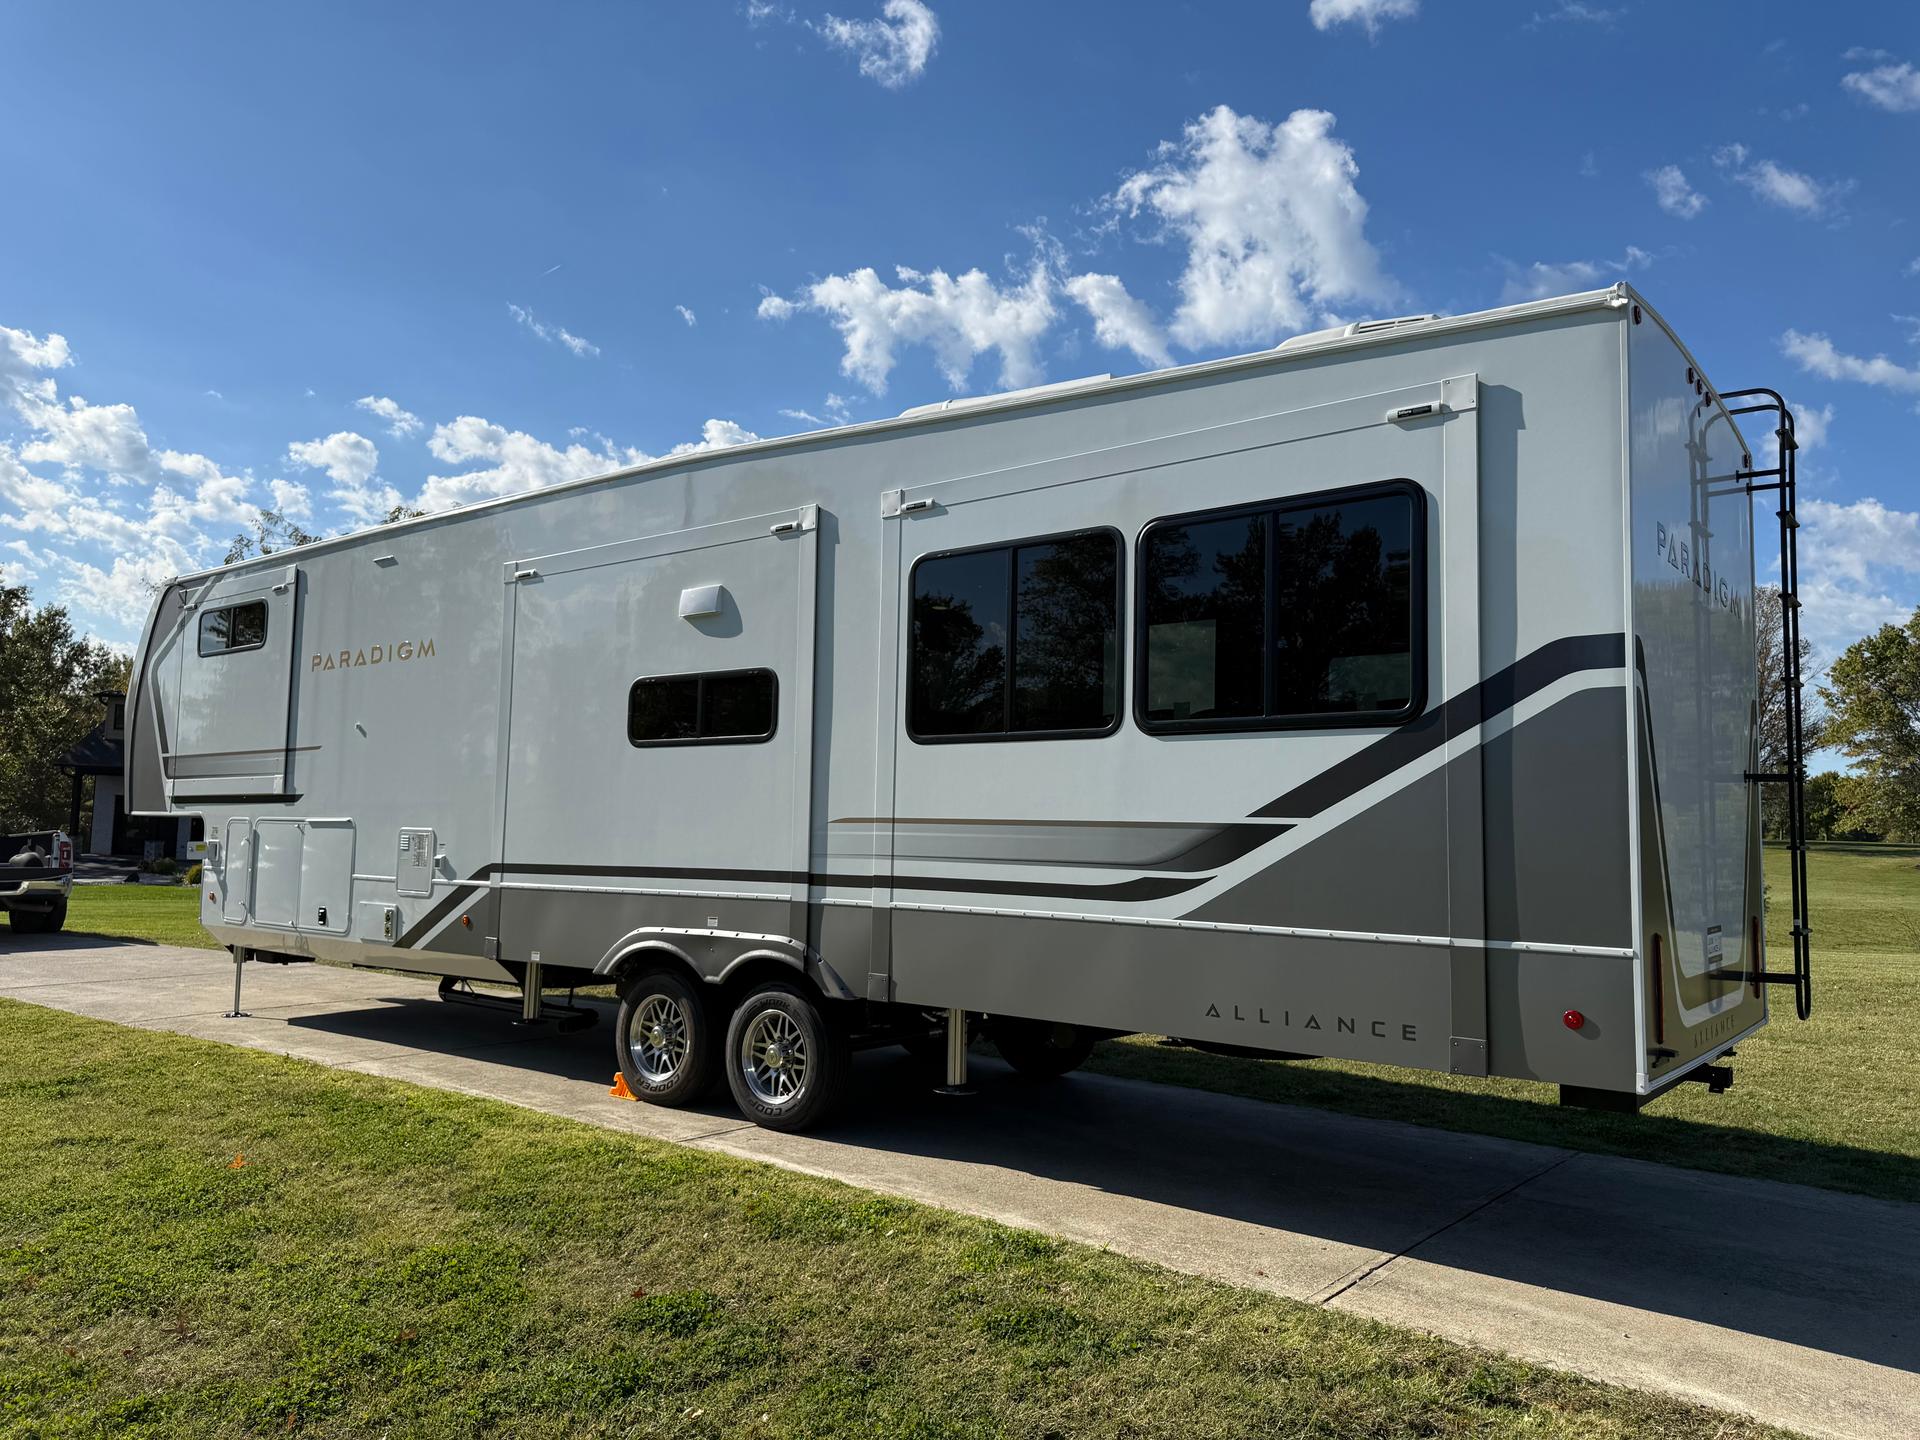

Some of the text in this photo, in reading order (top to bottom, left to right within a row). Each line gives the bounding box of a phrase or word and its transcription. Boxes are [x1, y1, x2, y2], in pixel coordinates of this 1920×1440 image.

[1656, 520, 1741, 620] PARADIGM
[310, 638, 436, 672] PARADIGM
[1204, 1003, 1417, 1042] ALLIANCE
